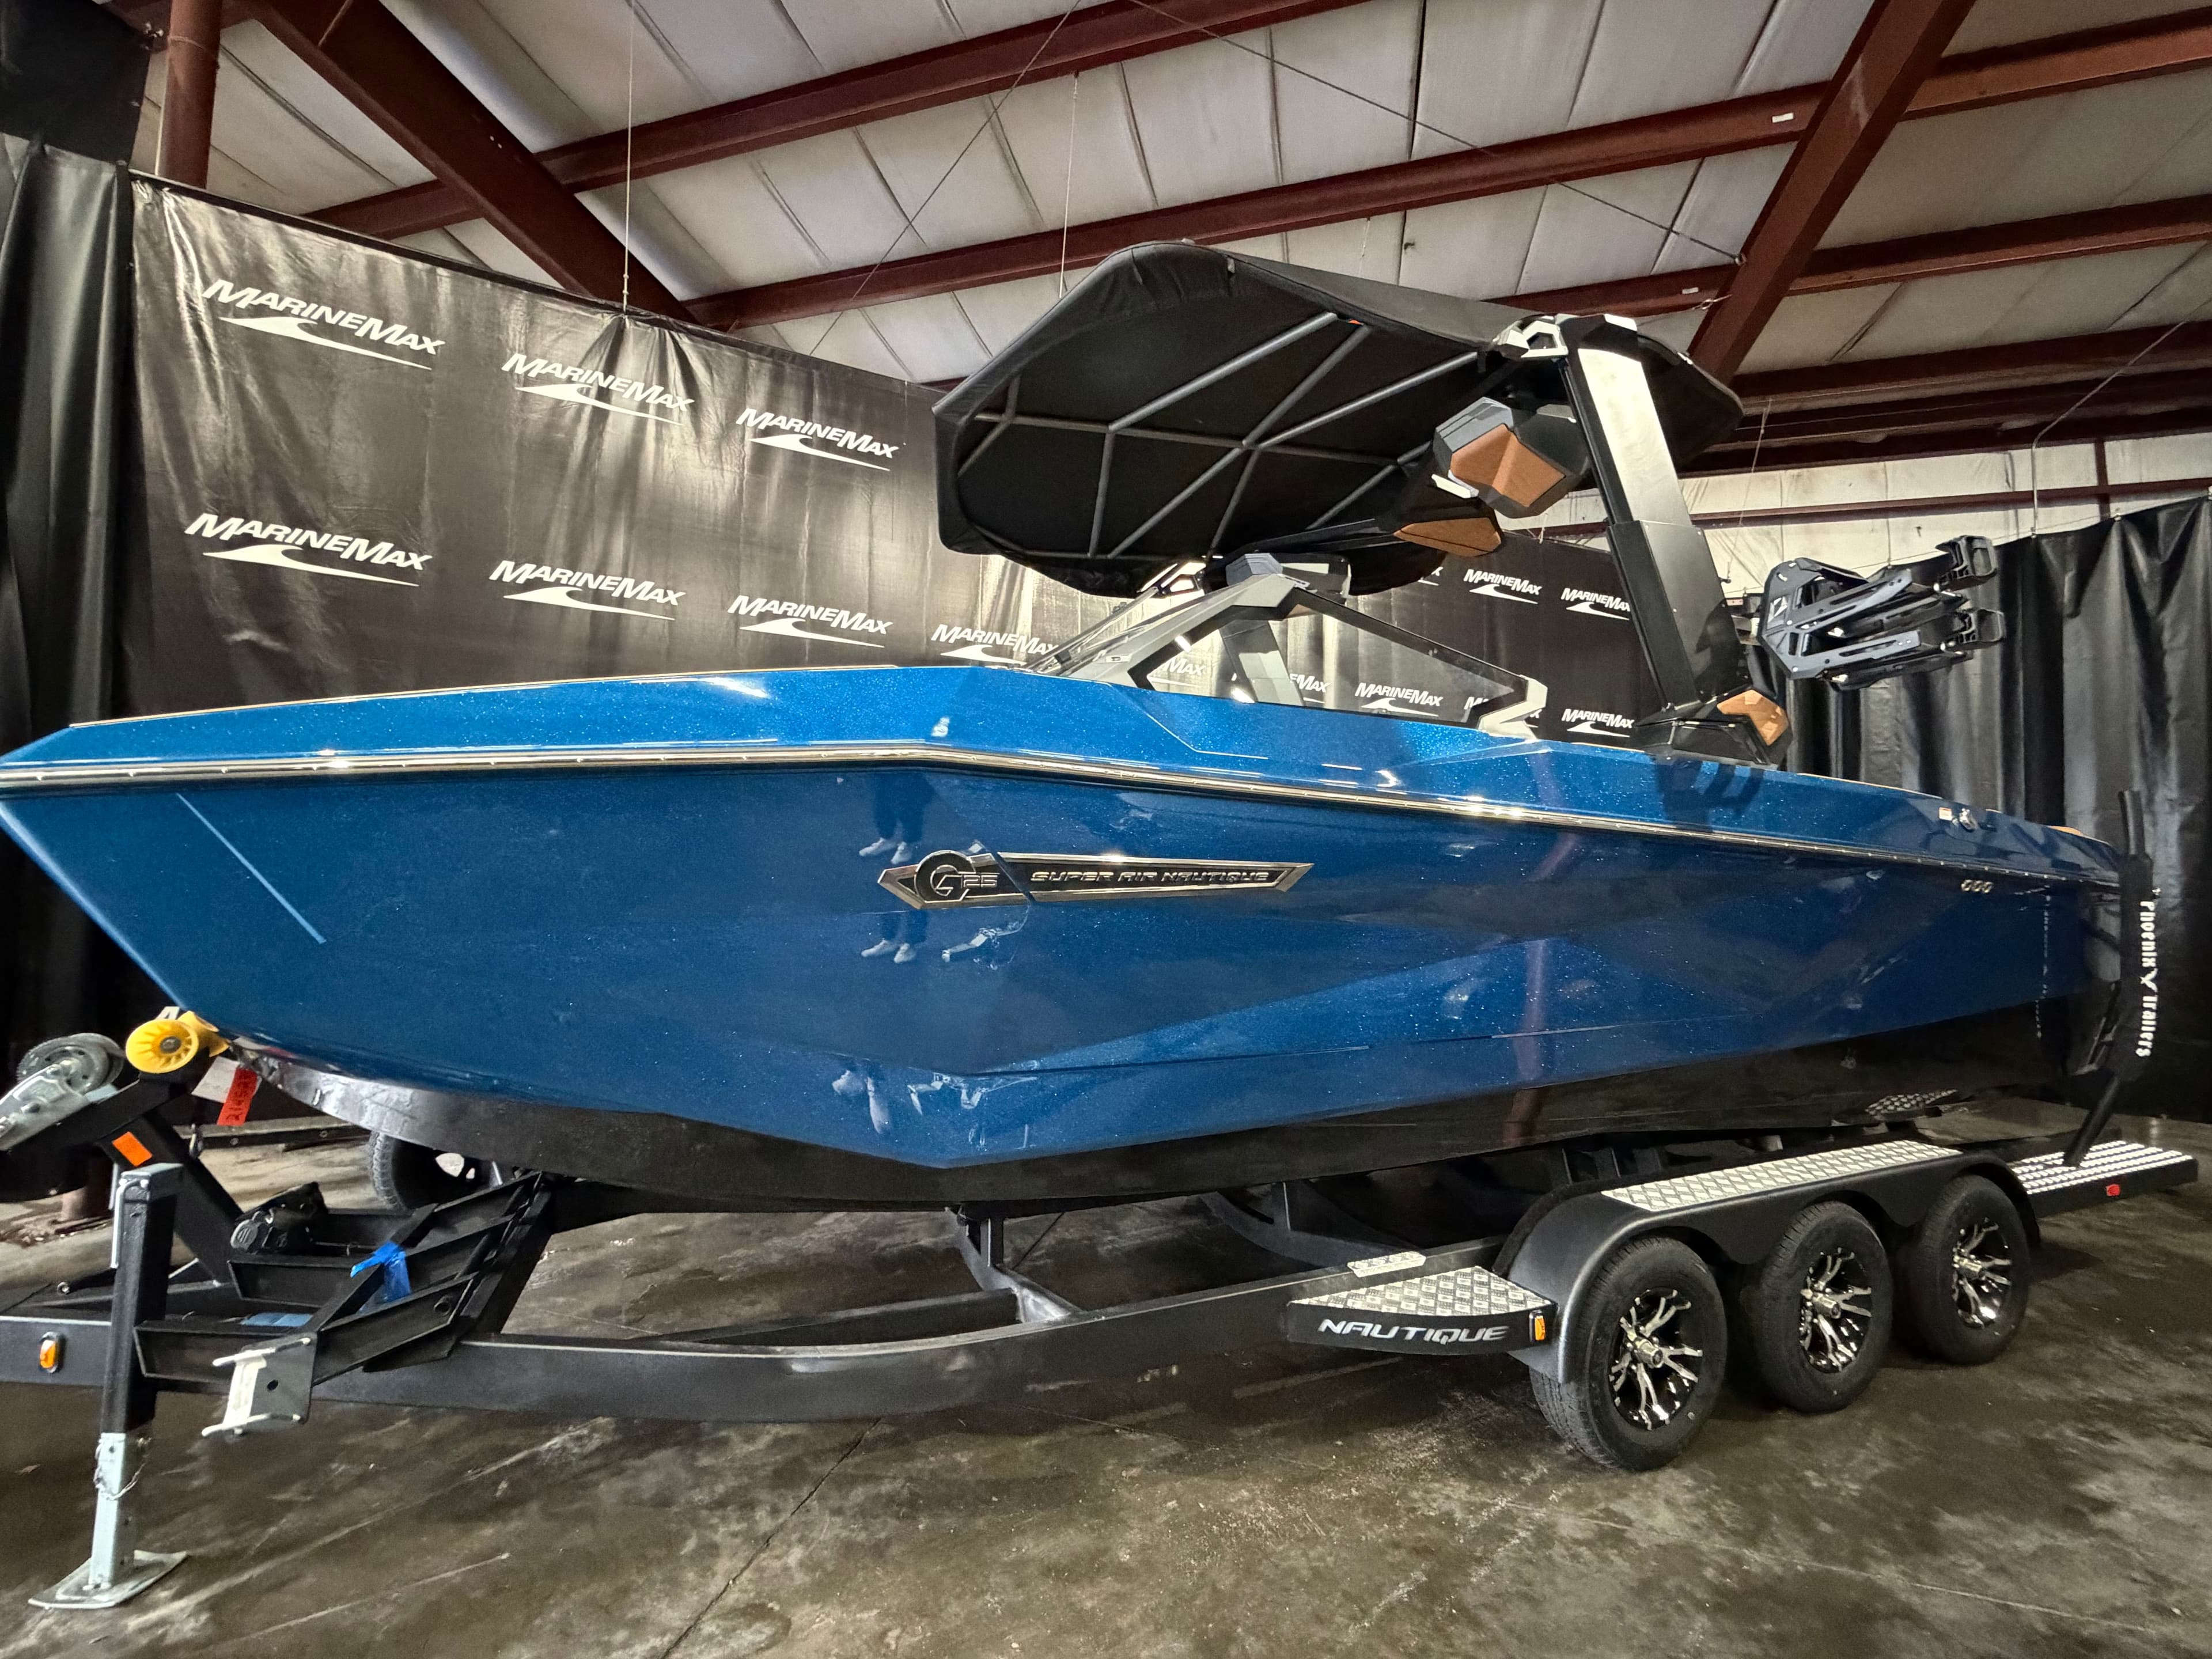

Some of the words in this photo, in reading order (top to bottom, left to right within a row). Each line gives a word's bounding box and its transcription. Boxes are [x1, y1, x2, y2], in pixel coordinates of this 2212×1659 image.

[202, 279, 445, 355] MARINEMAX
[501, 353, 695, 411] MARINEMAX
[736, 408, 899, 459] MARINEMAX
[184, 513, 433, 570] MARINEMAX
[489, 560, 686, 606] MARINEMAX
[1463, 569, 1543, 595] MARINEMAX
[727, 595, 893, 635] MARINEMAX
[1030, 871, 1114, 882] SUPER
[1118, 872, 1157, 882] AIR
[1161, 871, 1269, 882] NAUTIQUE
[1318, 1318, 1510, 1345] NAUTIQUE
